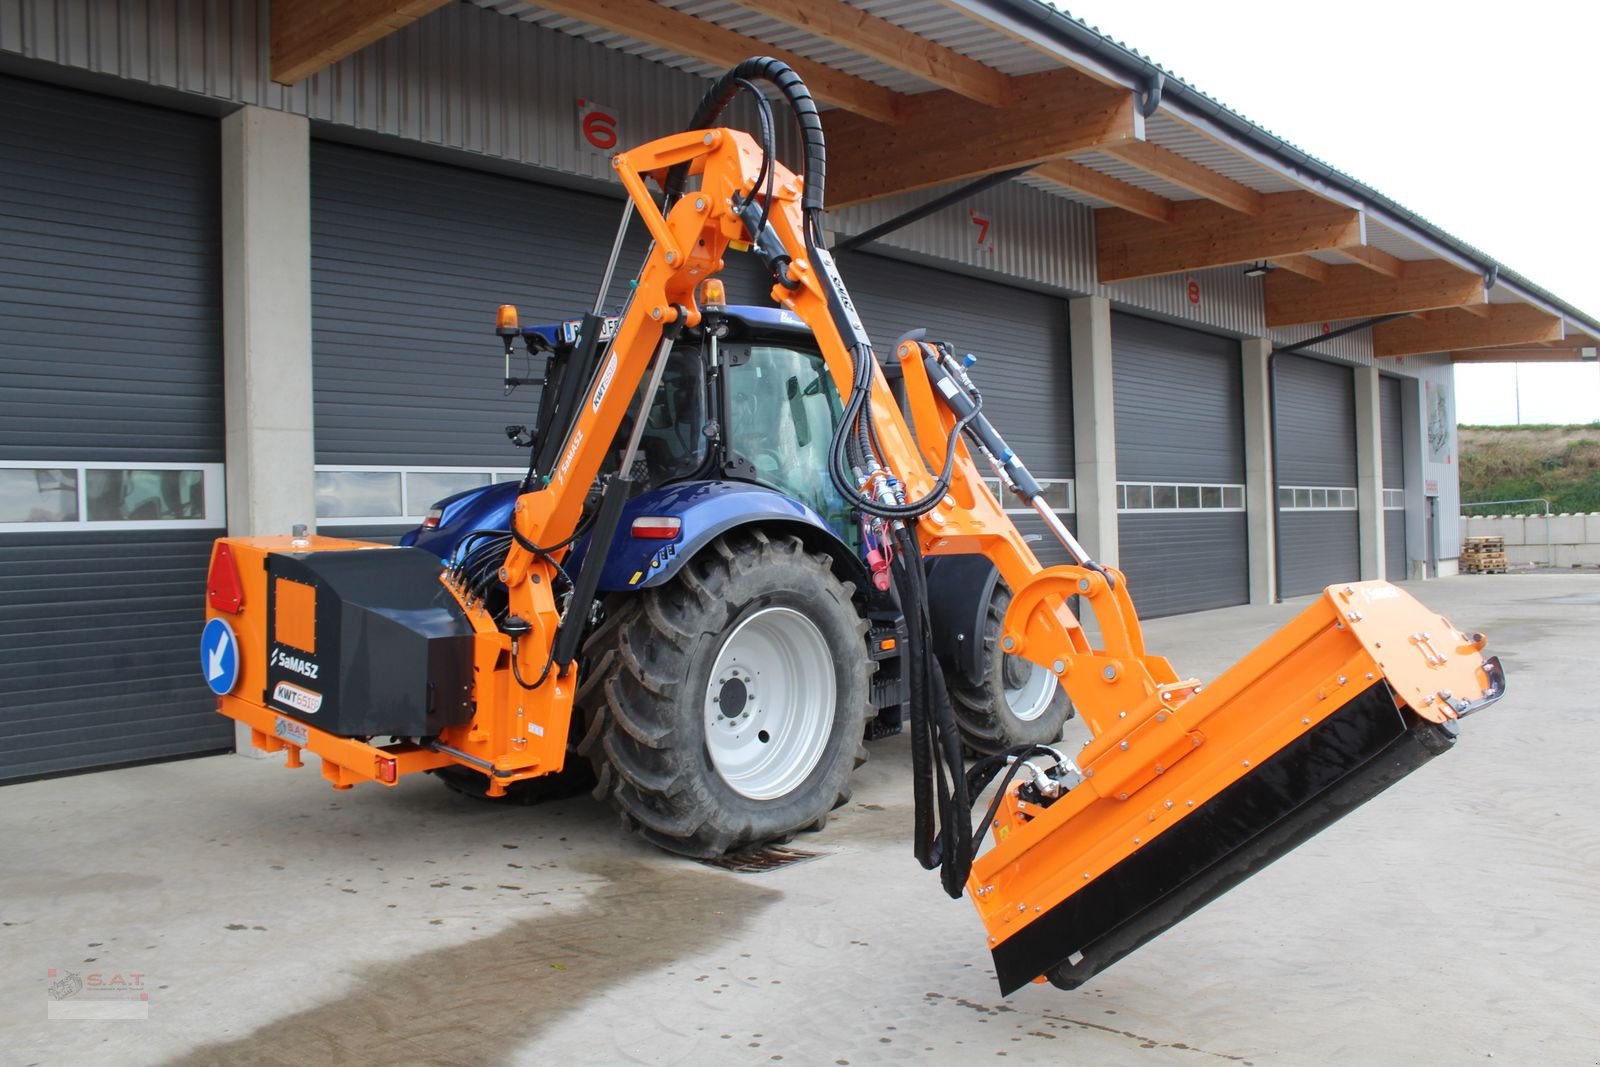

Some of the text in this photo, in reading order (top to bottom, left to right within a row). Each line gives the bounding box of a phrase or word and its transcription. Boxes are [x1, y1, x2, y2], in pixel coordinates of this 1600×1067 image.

[583, 112, 617, 149] 6
[972, 217, 990, 244] 7
[1188, 281, 1200, 304] 8
[561, 429, 583, 475] SaMASZ
[278, 651, 319, 679] SaMASZ
